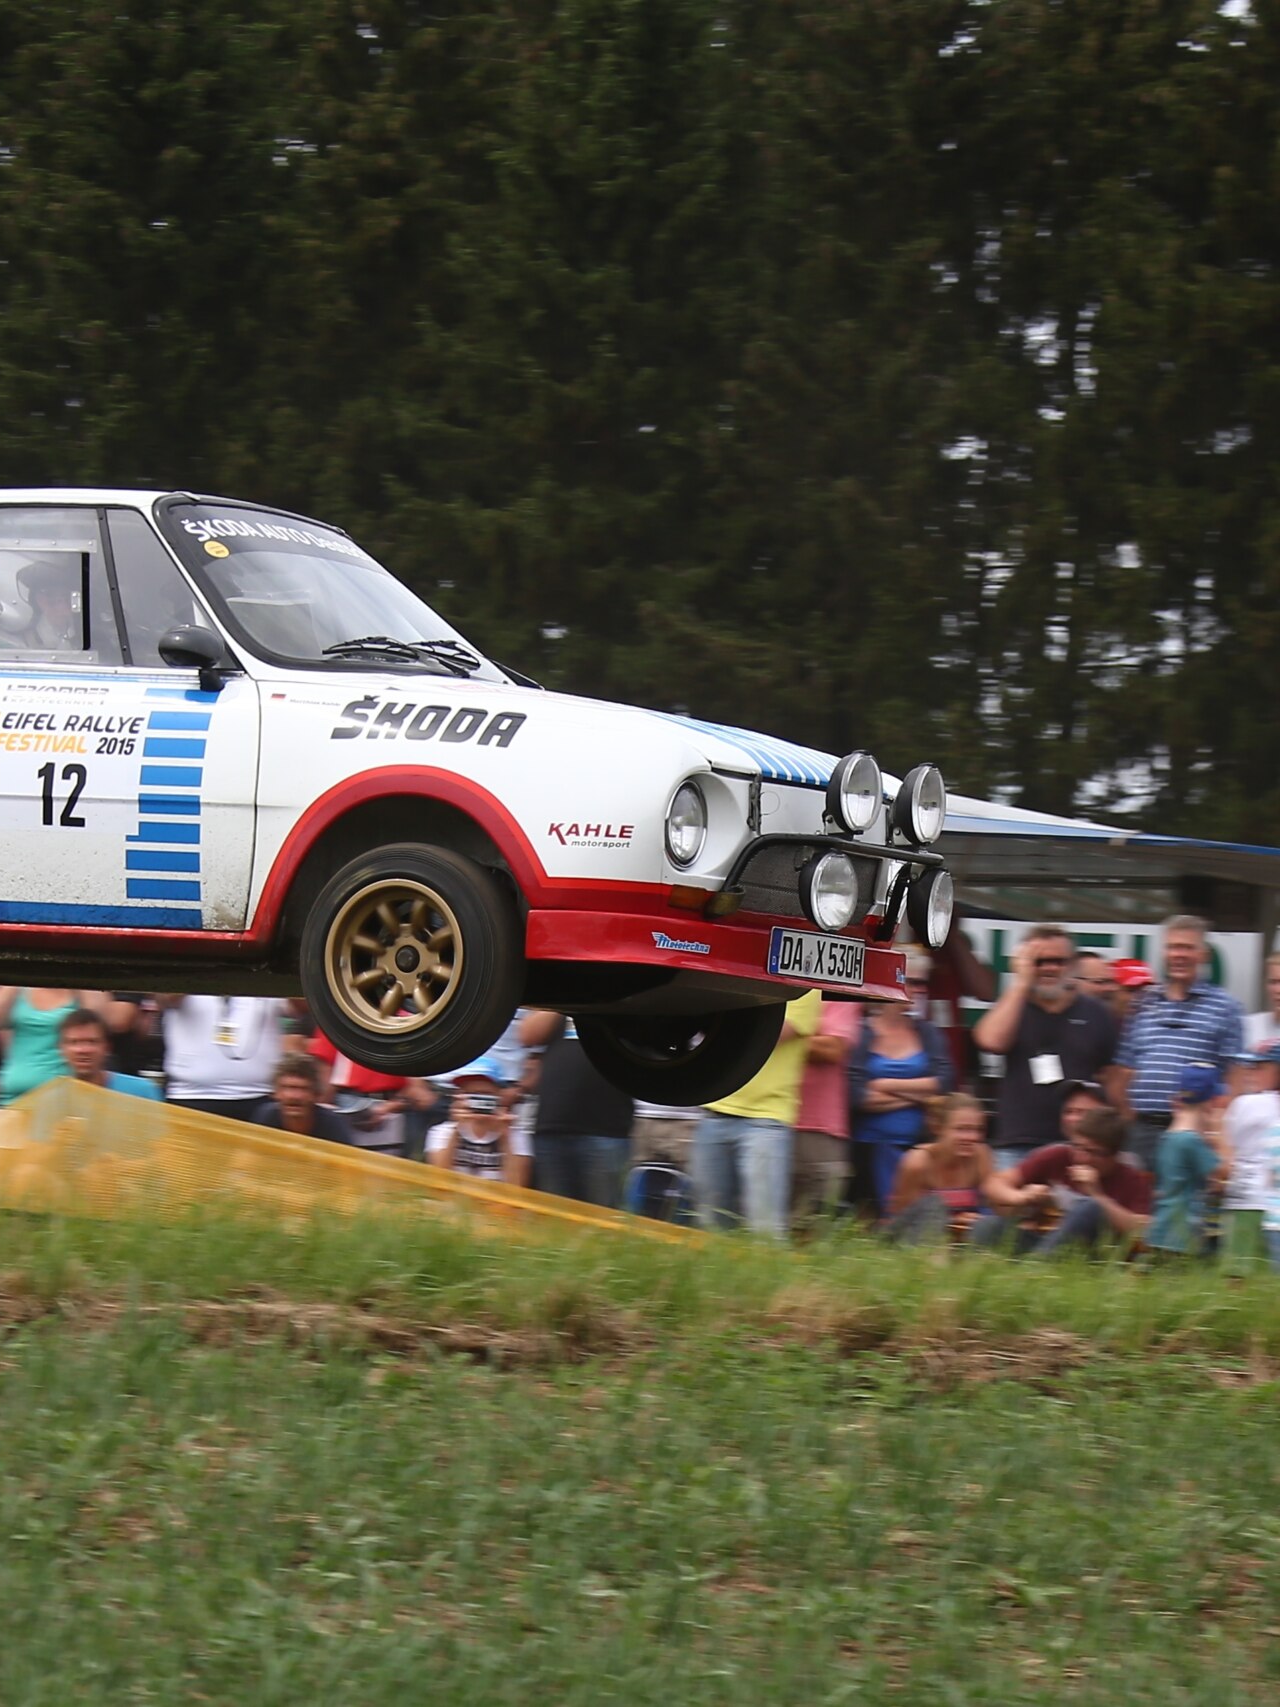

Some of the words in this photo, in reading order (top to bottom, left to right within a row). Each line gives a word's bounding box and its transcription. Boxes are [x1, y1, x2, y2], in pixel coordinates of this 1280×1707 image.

[181, 519, 260, 542] ŠKODA
[2, 712, 58, 731] EIFEL
[63, 714, 145, 734] RALLYE
[330, 695, 527, 748] ŠKODA
[95, 736, 136, 755] 2015
[37, 762, 87, 827] 12
[548, 823, 634, 845] KAHLE
[571, 840, 630, 848] motorsport
[780, 936, 803, 971] DA
[814, 940, 826, 974] X
[828, 942, 864, 980] 530H
